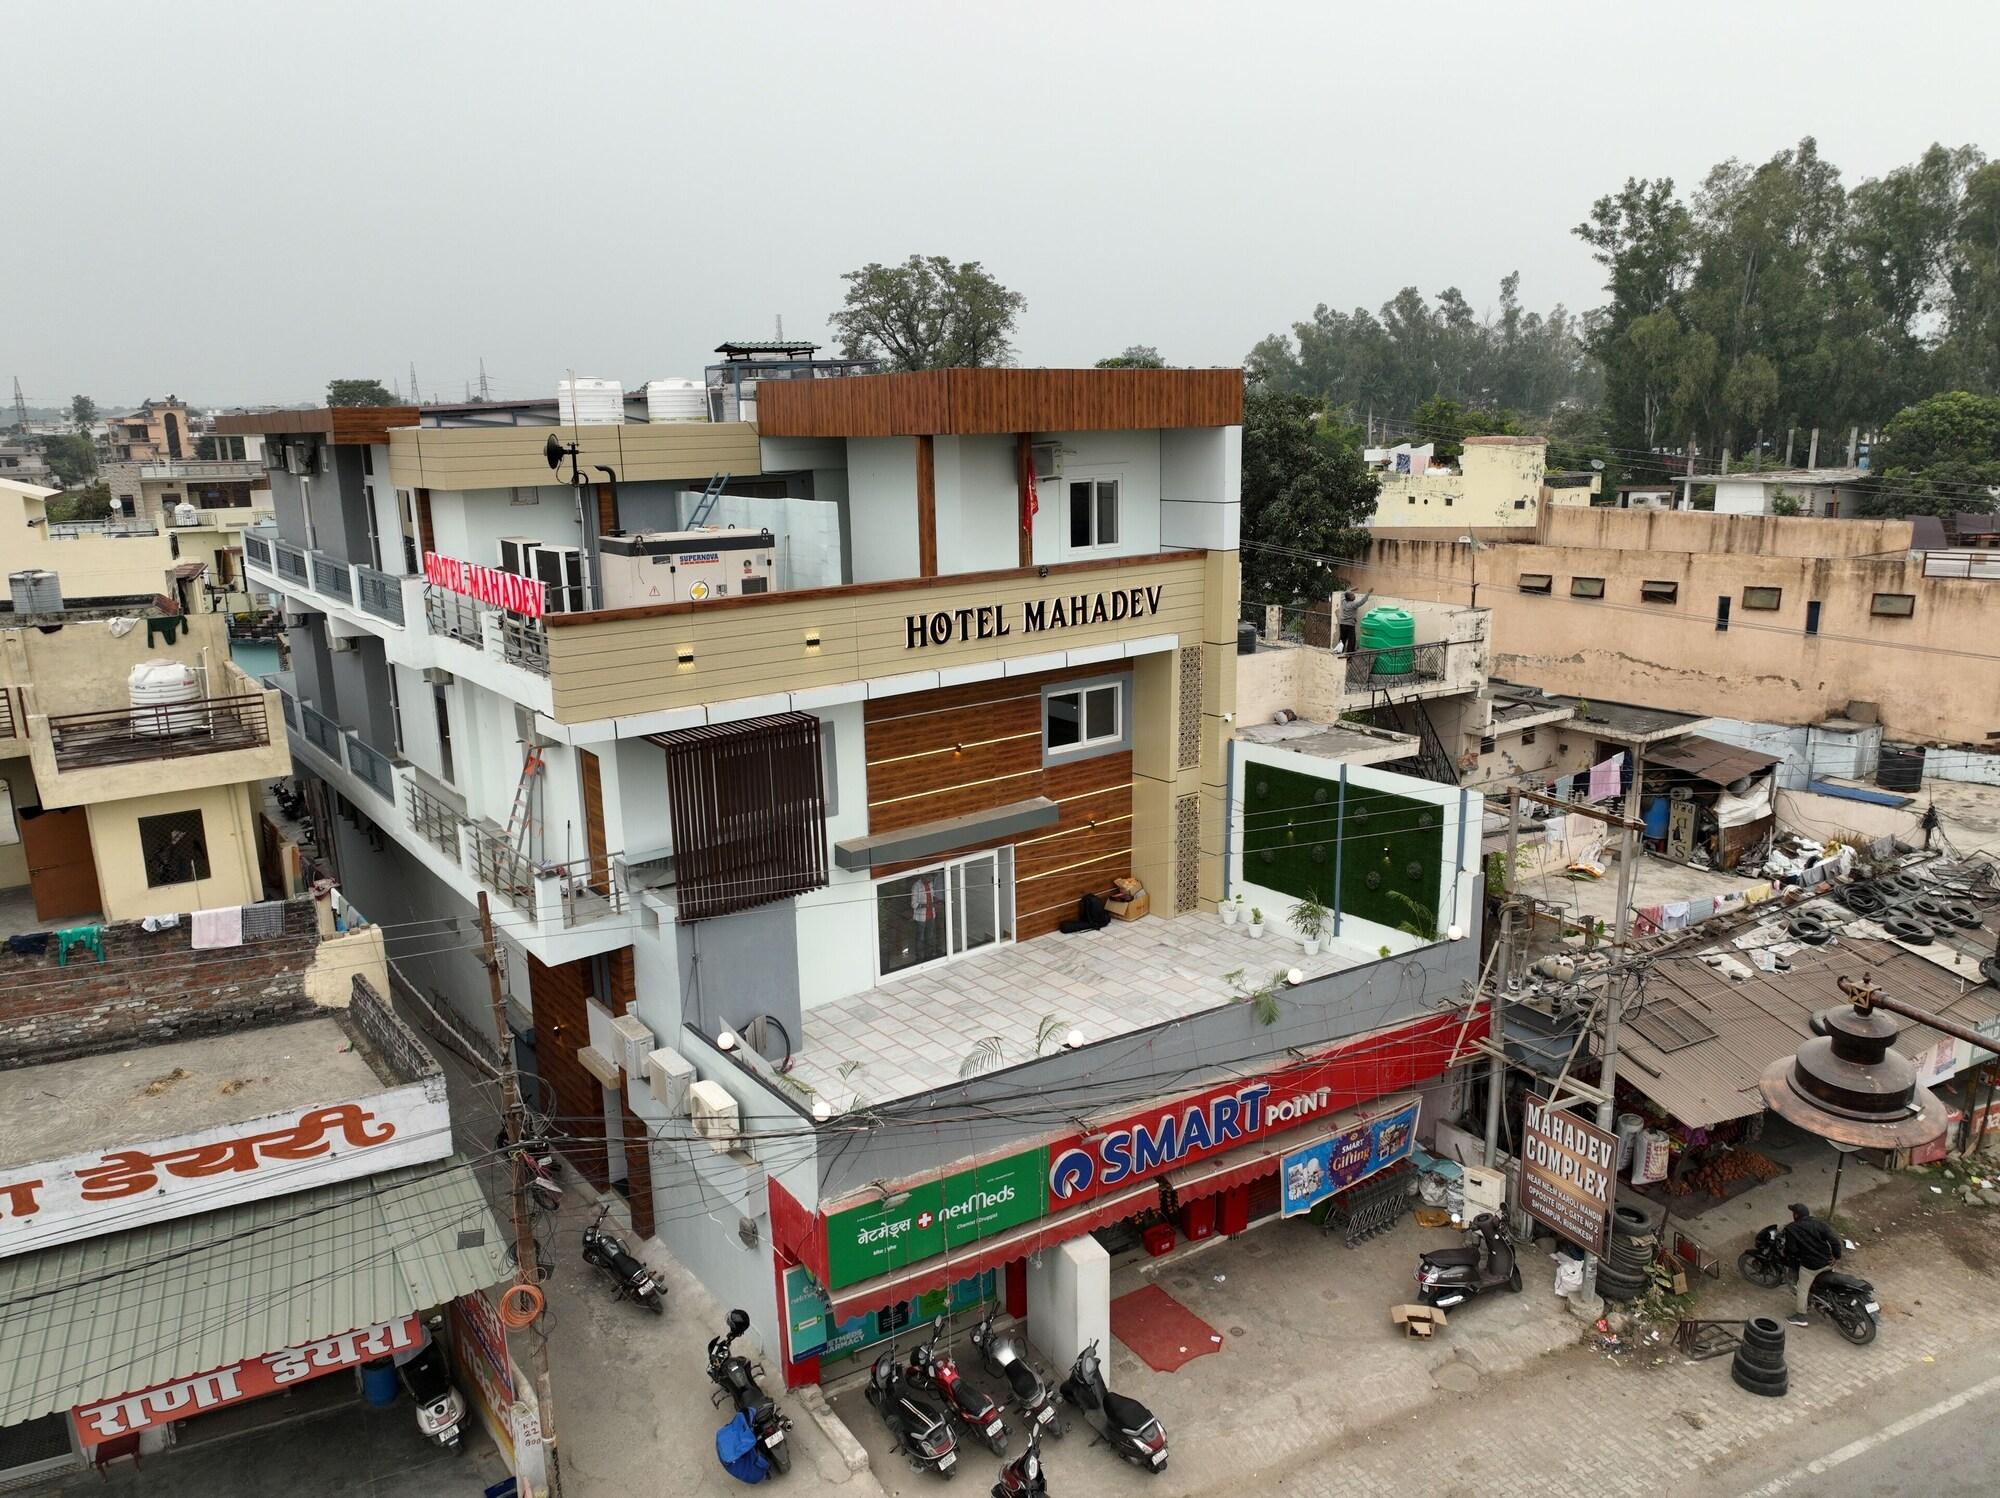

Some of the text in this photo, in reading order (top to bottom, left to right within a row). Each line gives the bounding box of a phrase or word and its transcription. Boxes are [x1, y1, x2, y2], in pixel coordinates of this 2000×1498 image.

[424, 553, 543, 620] HOTEL MAHADEV
[679, 552, 720, 562] SUPERNOVA
[905, 585, 1163, 649] HOTEL MAHADEV
[74, 1103, 396, 1202] डेयरी
[1101, 1082, 1332, 1185] SMART POINT
[1332, 1147, 1370, 1172] Gifting
[1342, 1138, 1365, 1154] SMART
[1527, 1102, 1612, 1170] MAHADEV
[1526, 1134, 1609, 1203] COMPLEX
[1526, 1172, 1542, 1187] NEAR
[1558, 1191, 1579, 1210] KAROLI
[1579, 1203, 1603, 1224] MANDIR
[1528, 1185, 1599, 1234] OPPOSITE IDPL GATE NO 2
[1562, 1218, 1594, 1243] RISHIKESH
[80, 1366, 243, 1437] राणा
